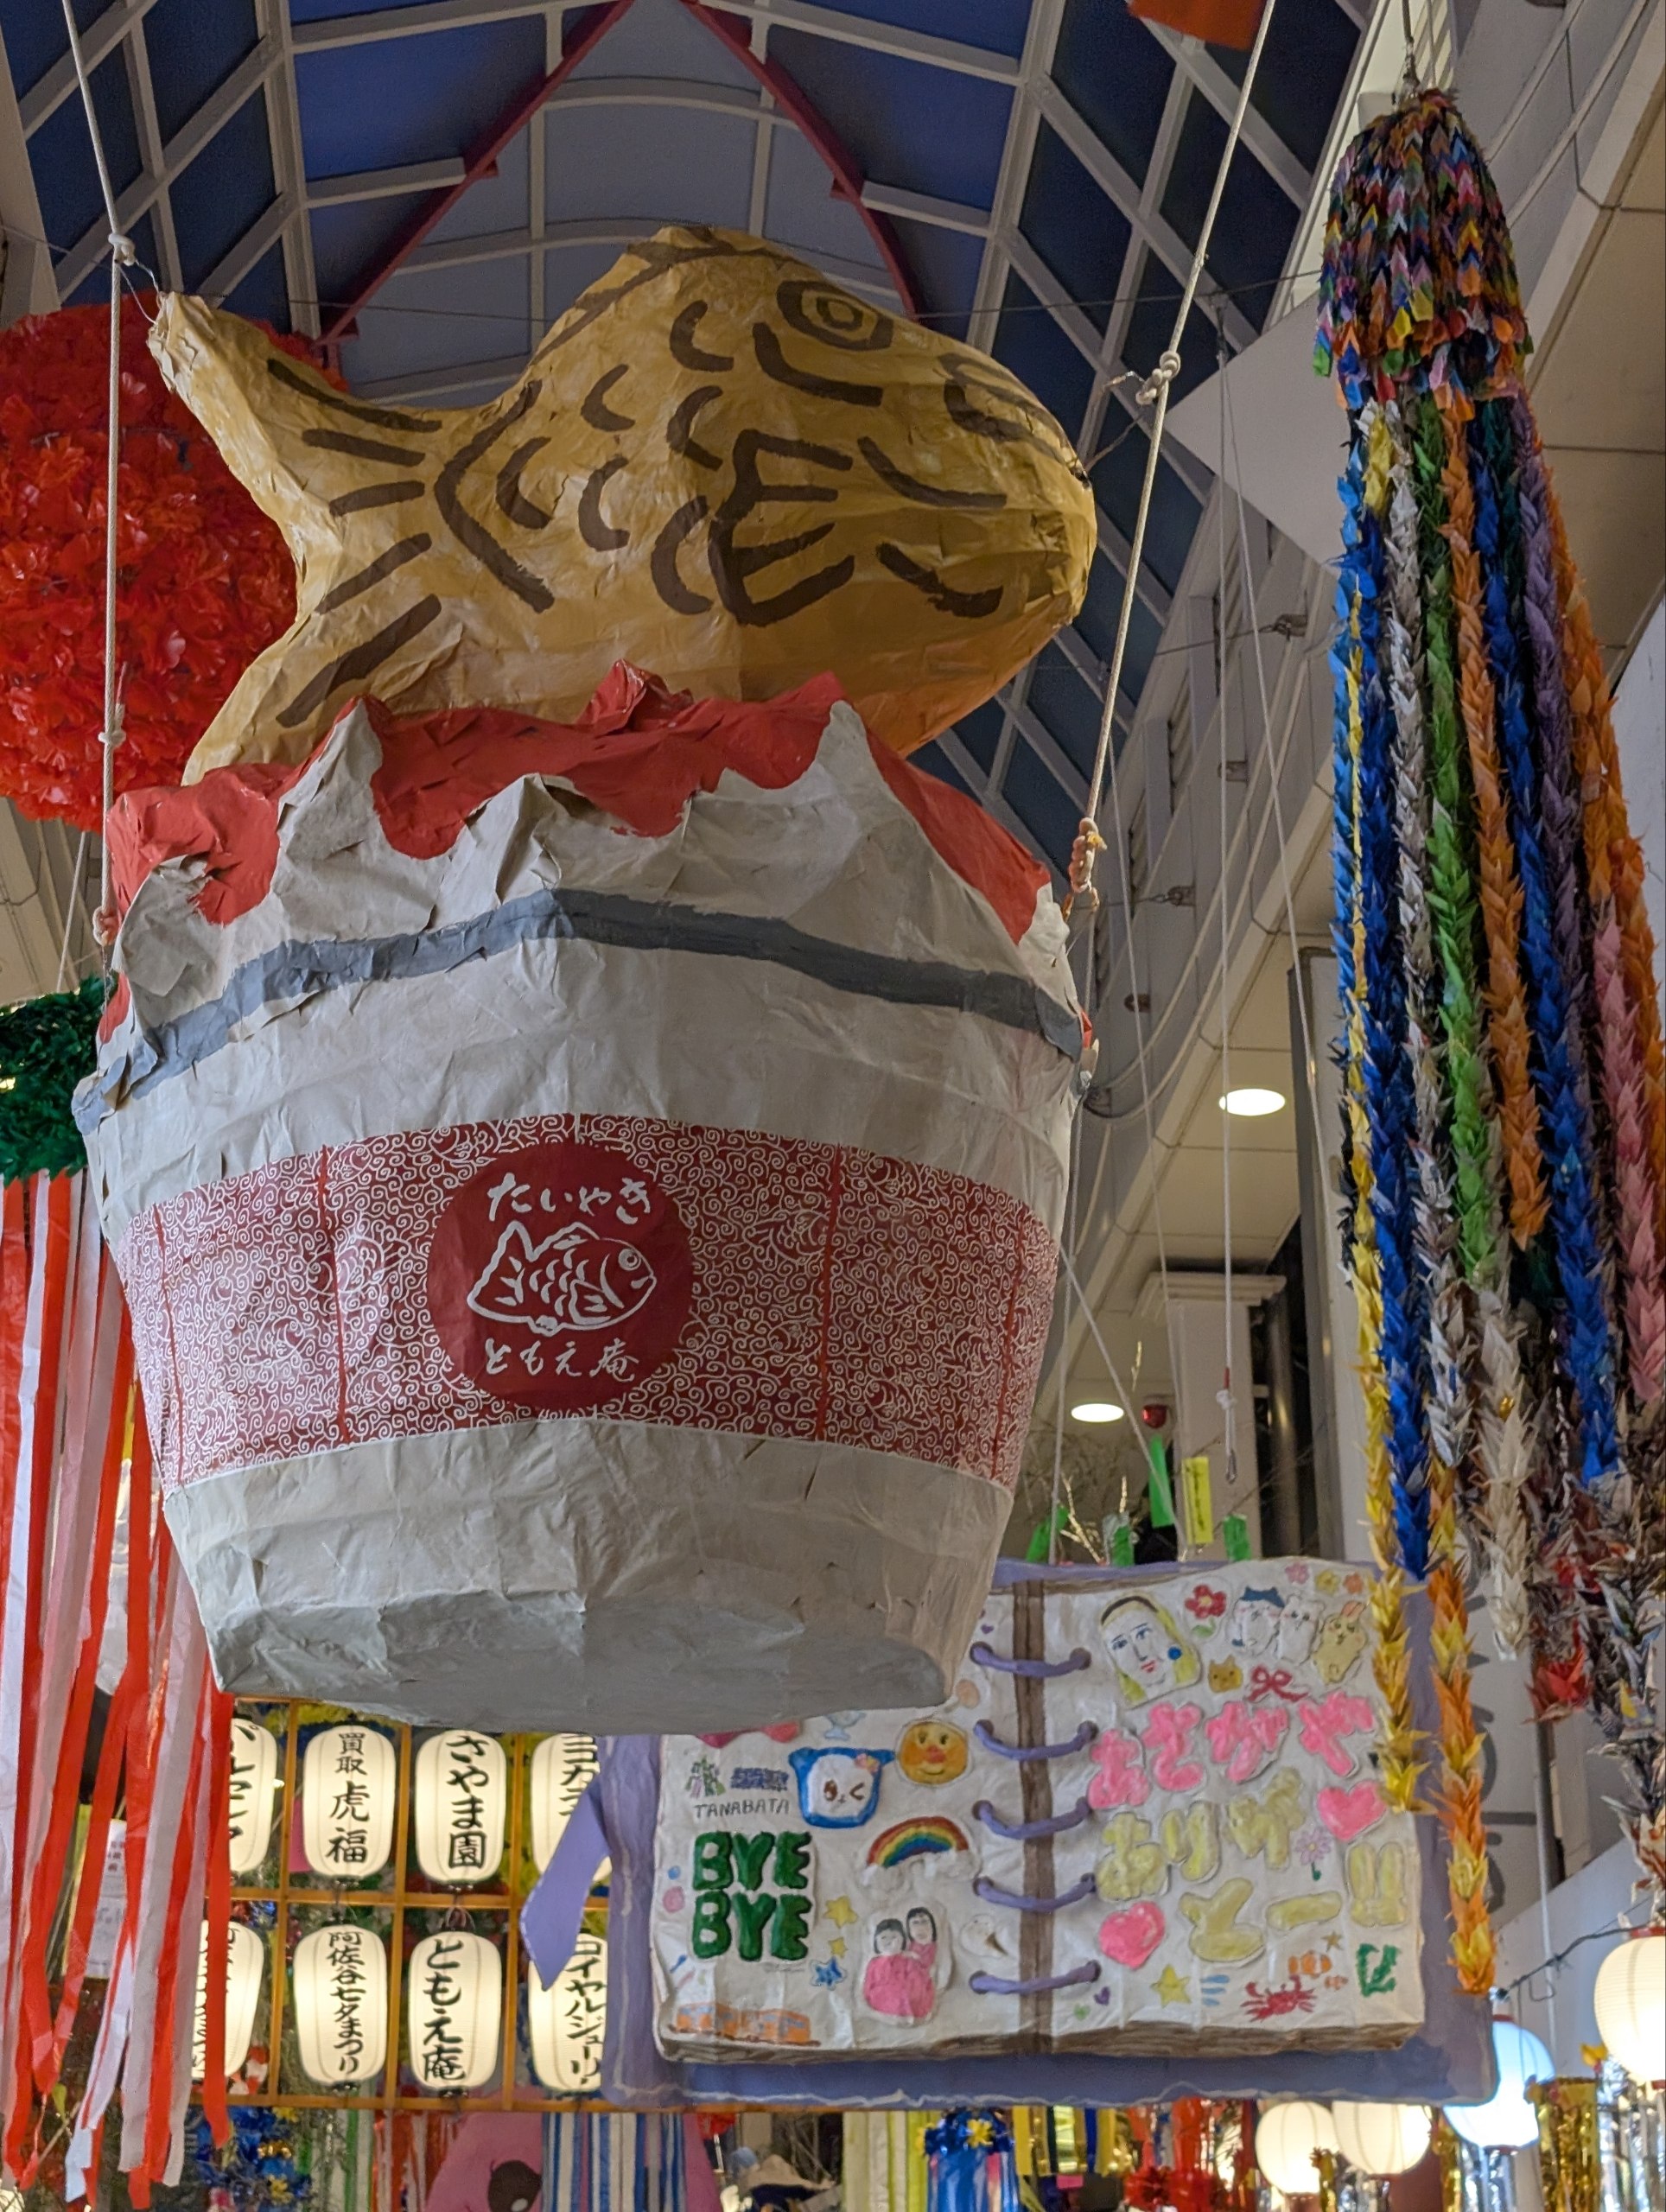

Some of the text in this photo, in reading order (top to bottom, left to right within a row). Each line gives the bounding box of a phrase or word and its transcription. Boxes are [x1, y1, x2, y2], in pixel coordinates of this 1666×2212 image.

[487, 1173, 651, 1224] たいやき
[485, 1338, 639, 1382] ともえ庵
[446, 1735, 489, 1869] さやま園
[694, 1797, 790, 1819] TANABATA
[693, 1831, 812, 1891] BYE
[692, 1892, 812, 1961] BYE
[327, 1931, 366, 2075] 阿佐谷七夕まつり
[423, 1939, 467, 2081] ともえ庵
